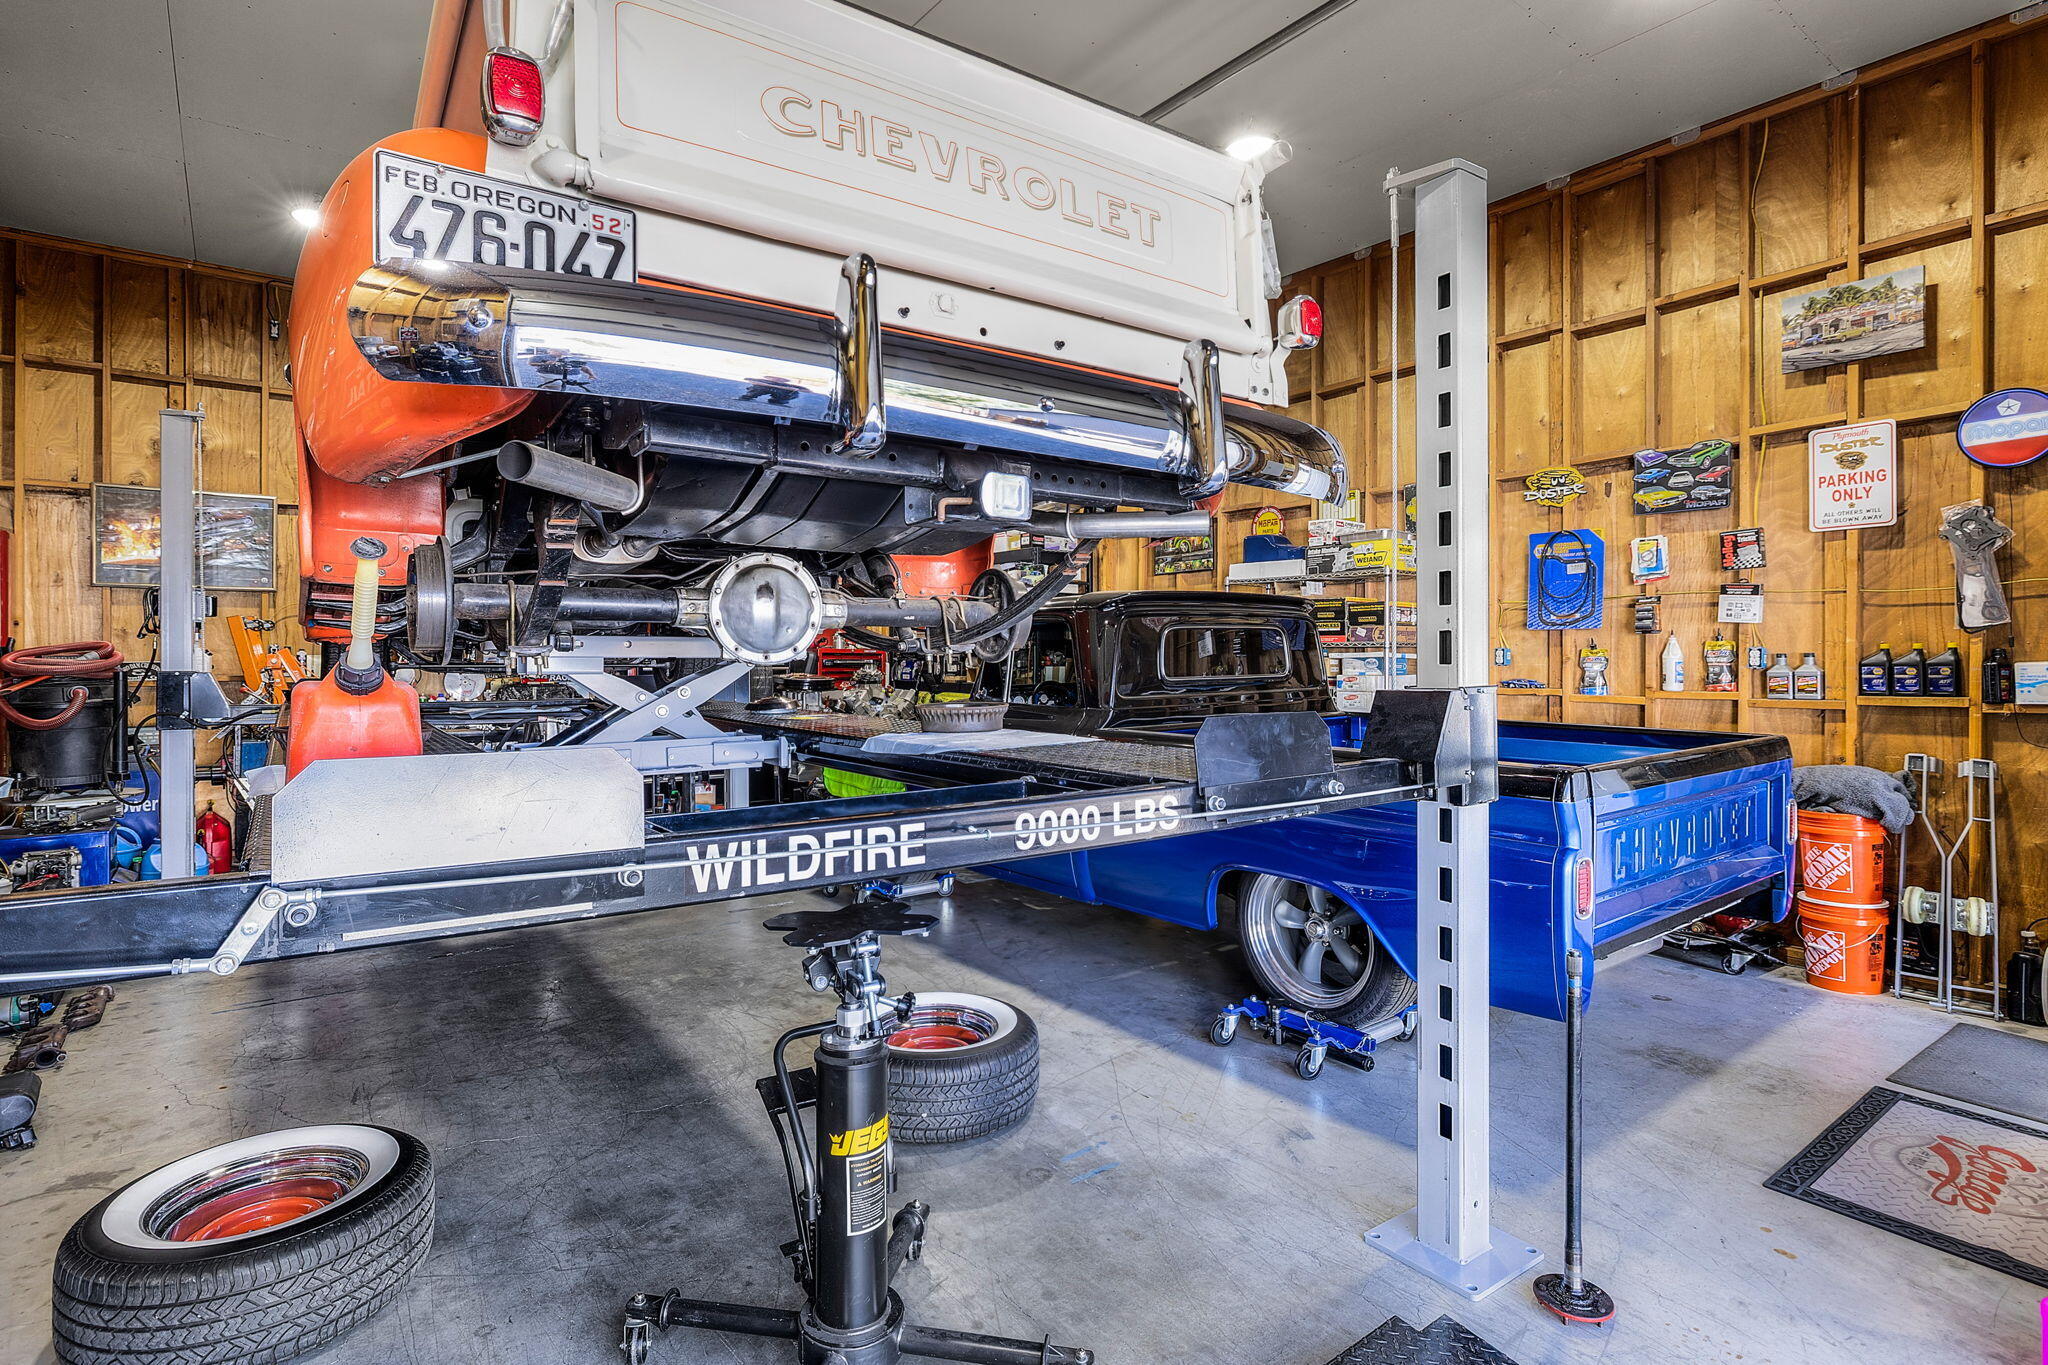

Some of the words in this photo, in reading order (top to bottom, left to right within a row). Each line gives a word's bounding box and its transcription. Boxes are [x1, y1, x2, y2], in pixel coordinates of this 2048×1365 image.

[760, 86, 1161, 247] CHEVROLET
[592, 213, 622, 235] 52
[1819, 436, 1885, 454] DUSTER
[1832, 428, 1870, 441] Plymouth
[1818, 468, 1888, 488] PARKING
[1524, 484, 1588, 501] DUSTER
[1686, 500, 1727, 508] MOPAR
[1832, 486, 1873, 502] ONLY
[1722, 535, 1736, 567] Holley
[1015, 805, 1101, 851] 9000
[1114, 795, 1180, 837] LBS
[1615, 800, 1751, 880] CHEVROLET
[685, 821, 927, 893] WILDFIRE
[1804, 843, 1850, 887] HOME
[1805, 846, 1822, 863] THE
[1817, 862, 1851, 889] DEPOT
[1811, 949, 1845, 976] DEPOT
